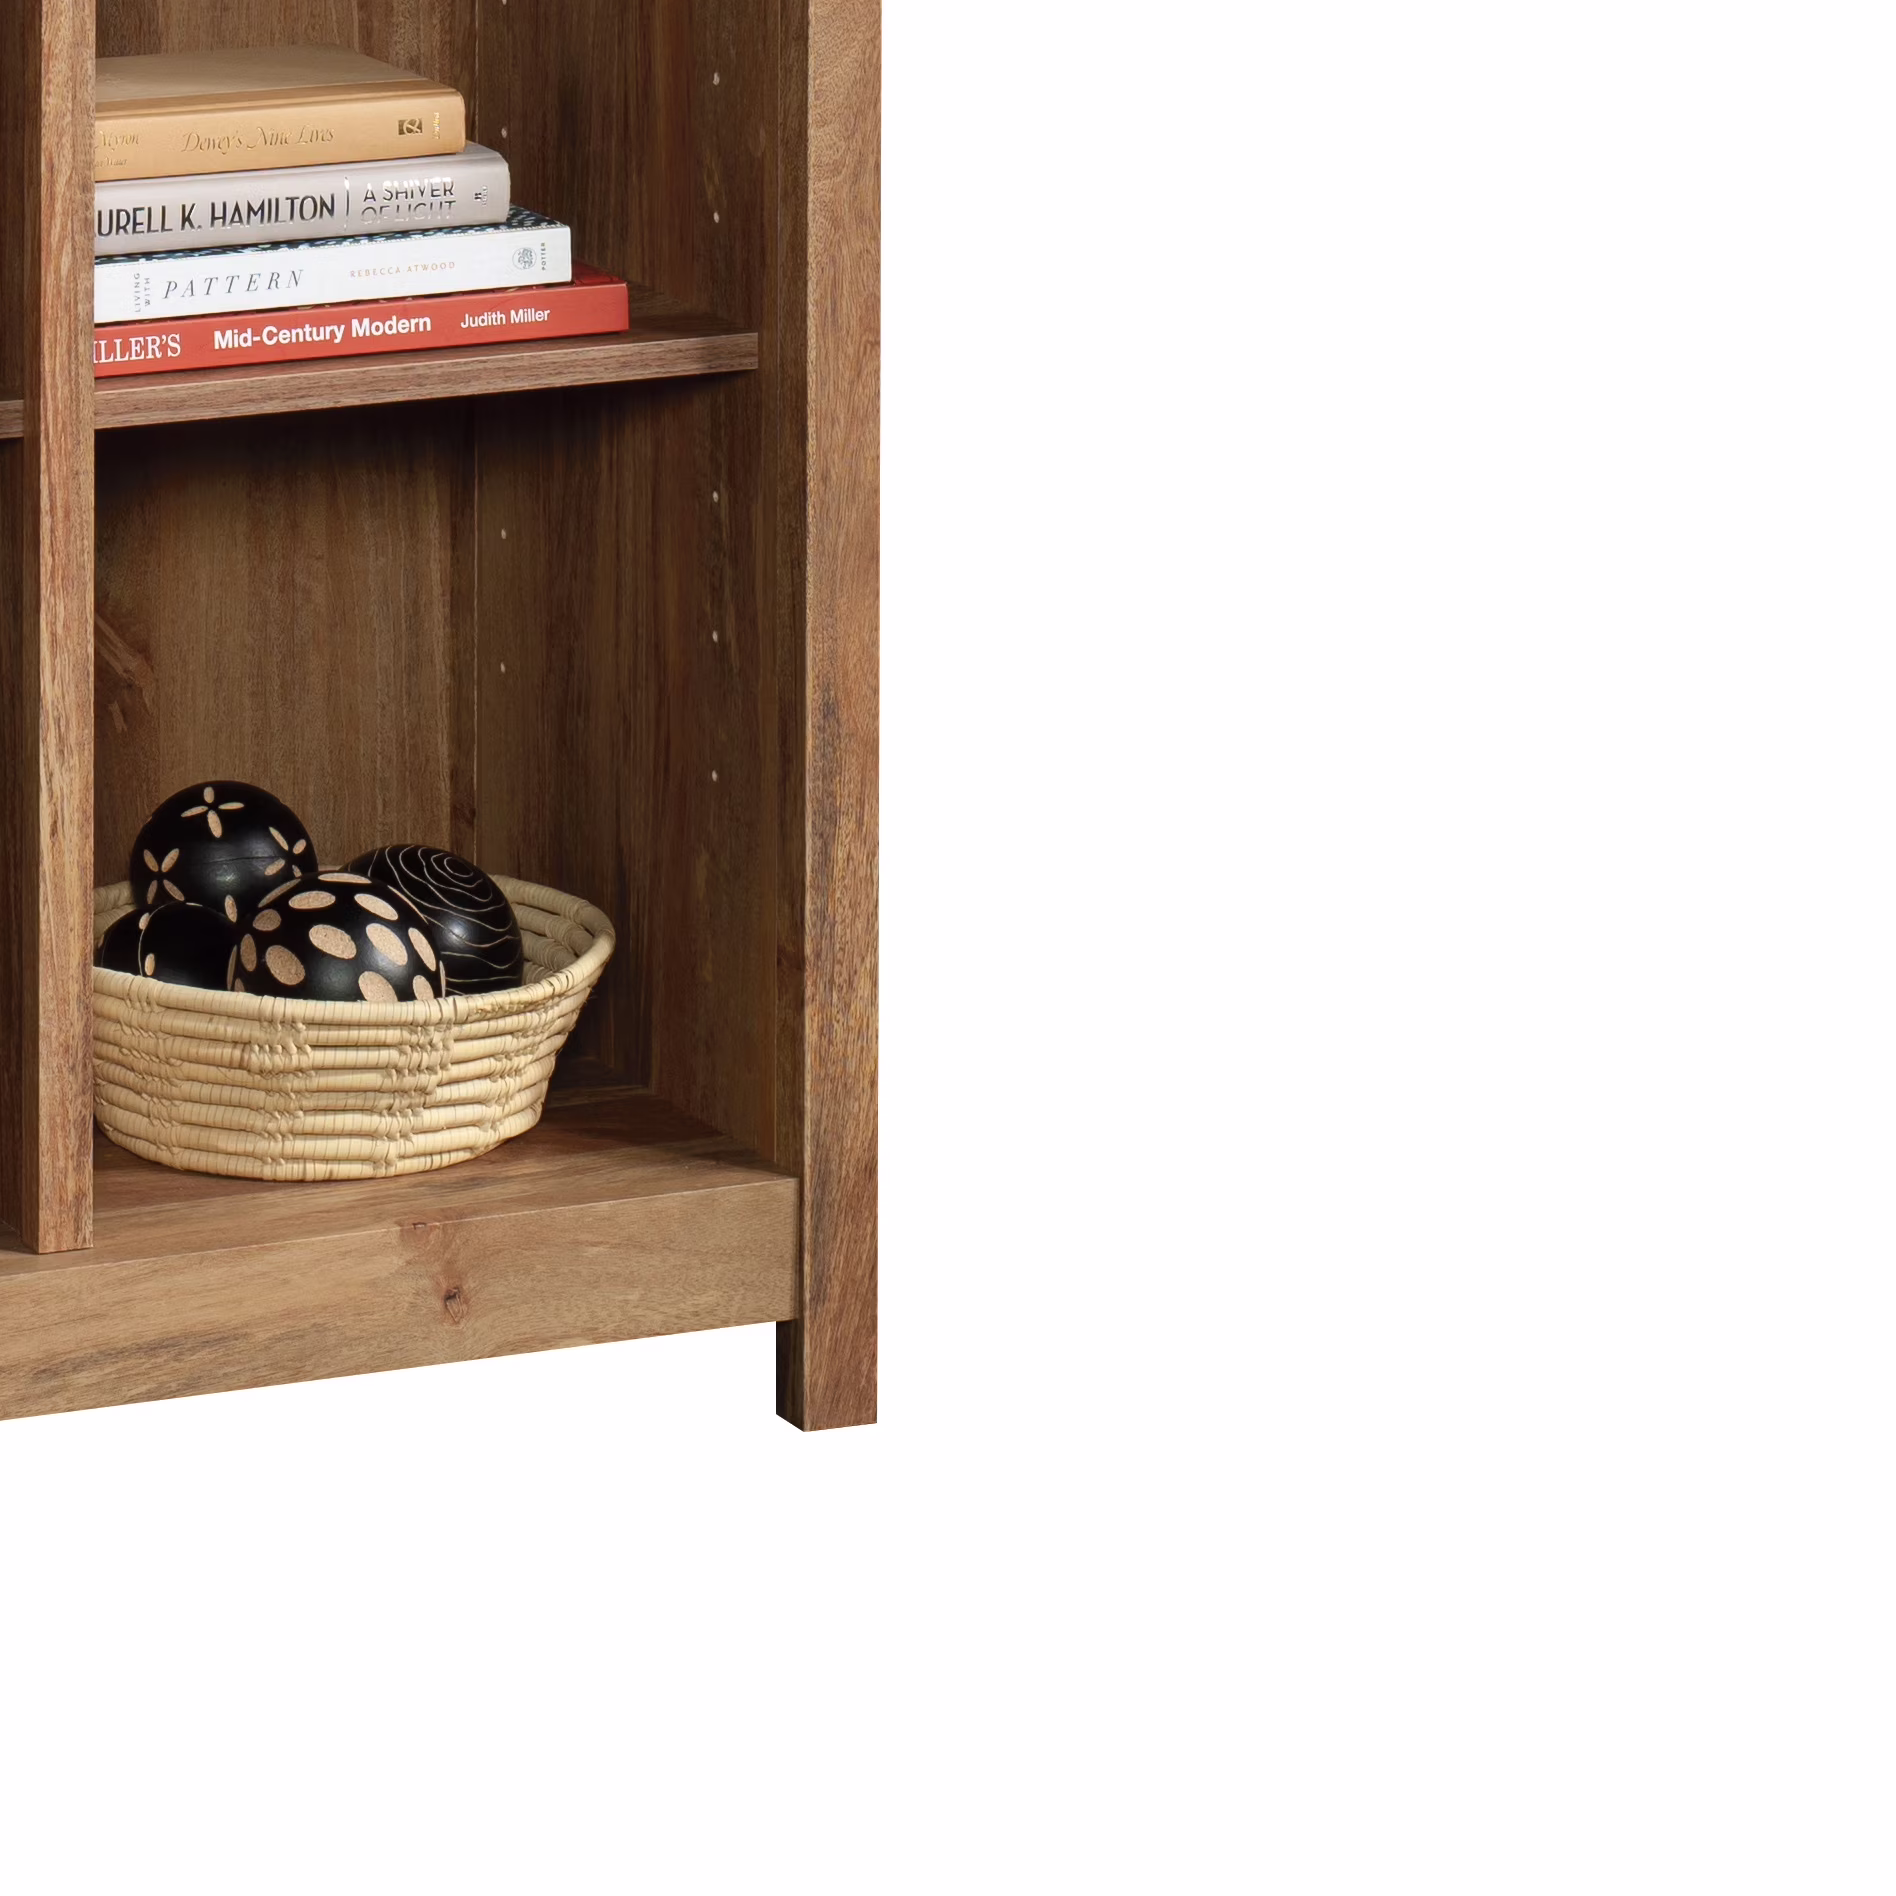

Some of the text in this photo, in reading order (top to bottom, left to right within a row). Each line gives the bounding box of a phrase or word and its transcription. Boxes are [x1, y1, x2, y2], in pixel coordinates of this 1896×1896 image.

[181, 131, 243, 155] Dewey's
[247, 126, 292, 149] Nine
[295, 124, 335, 145] Lives
[363, 183, 376, 203] A
[382, 177, 455, 202] SHIVER
[94, 193, 335, 237] URELL K. HAMILTON
[361, 203, 390, 224] OF
[162, 269, 304, 299] PATTERN
[350, 261, 455, 278] REBECCA ATWOOD
[133, 272, 141, 313] LIVING
[460, 307, 550, 329] Judith Miller
[93, 315, 431, 364] ILLER'S Mid-Century Modern
